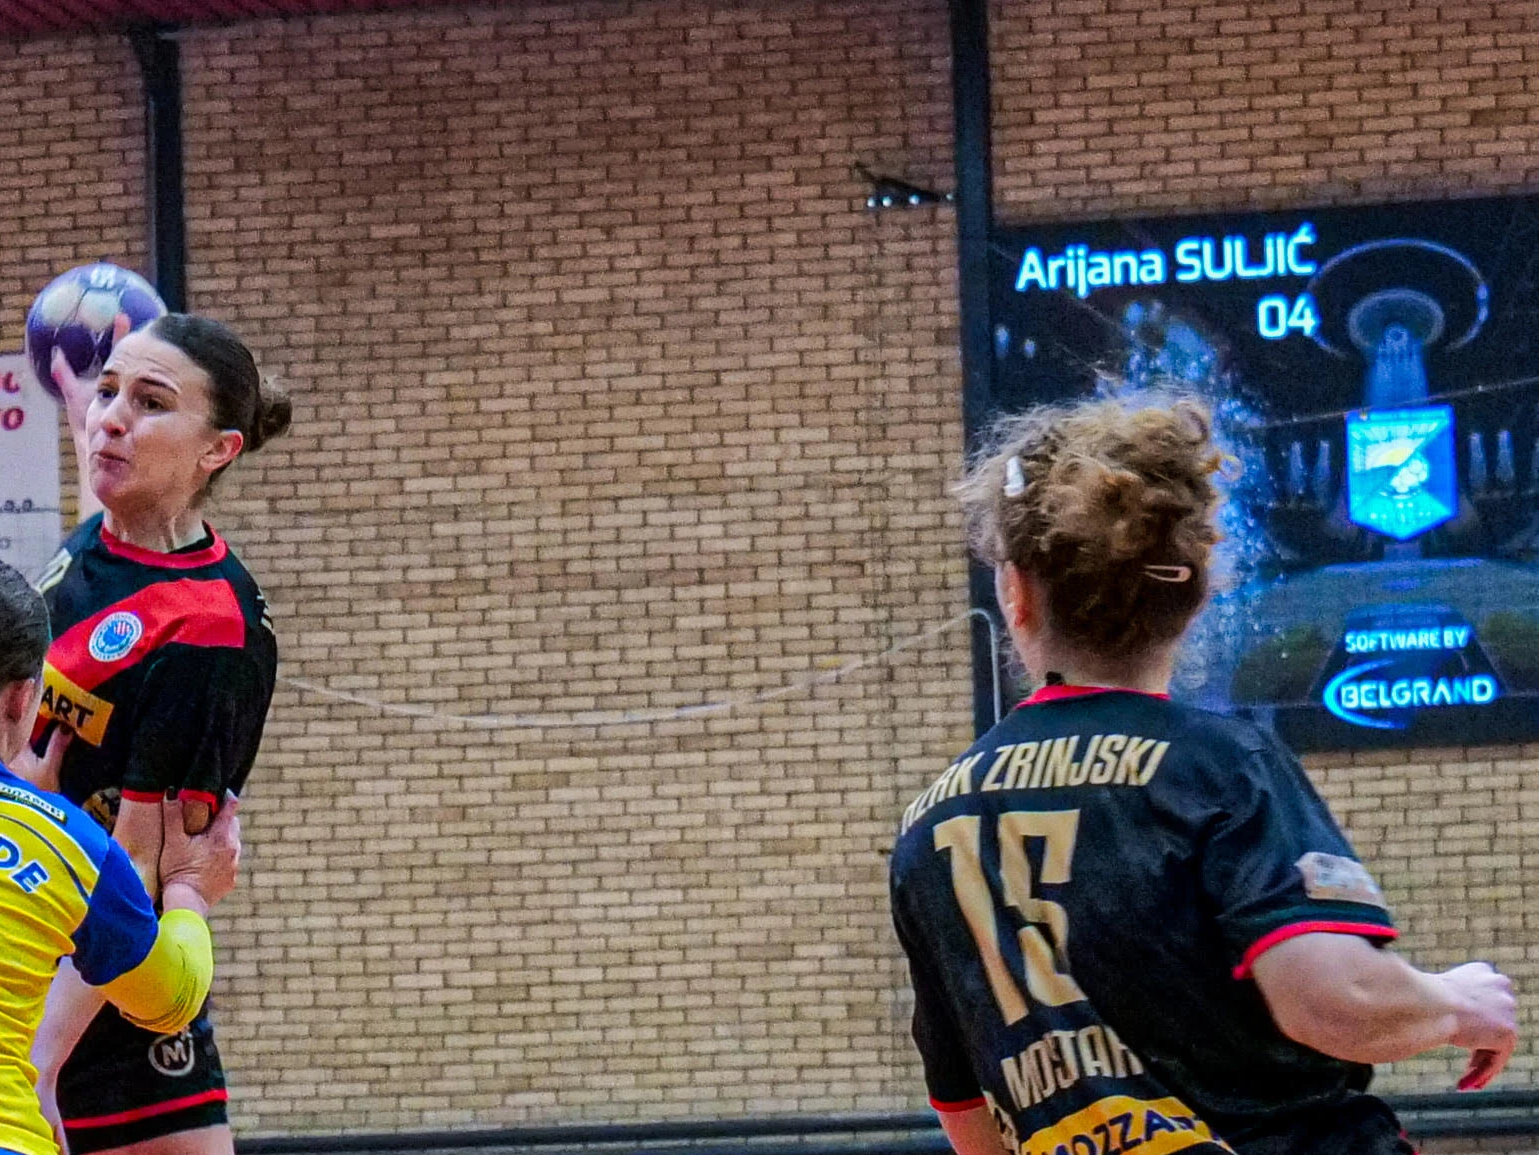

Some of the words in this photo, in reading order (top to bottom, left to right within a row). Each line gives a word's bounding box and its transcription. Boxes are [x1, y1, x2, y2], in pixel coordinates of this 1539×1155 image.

[1015, 245, 1165, 299] Arijana
[1175, 222, 1317, 281] SULJIĆ
[1258, 295, 1317, 338] 04
[1345, 630, 1441, 653] SOFTWARE
[1443, 626, 1470, 649] BY
[1341, 678, 1495, 709] BELGRAND
[981, 734, 1170, 792] ZRINJSKI
